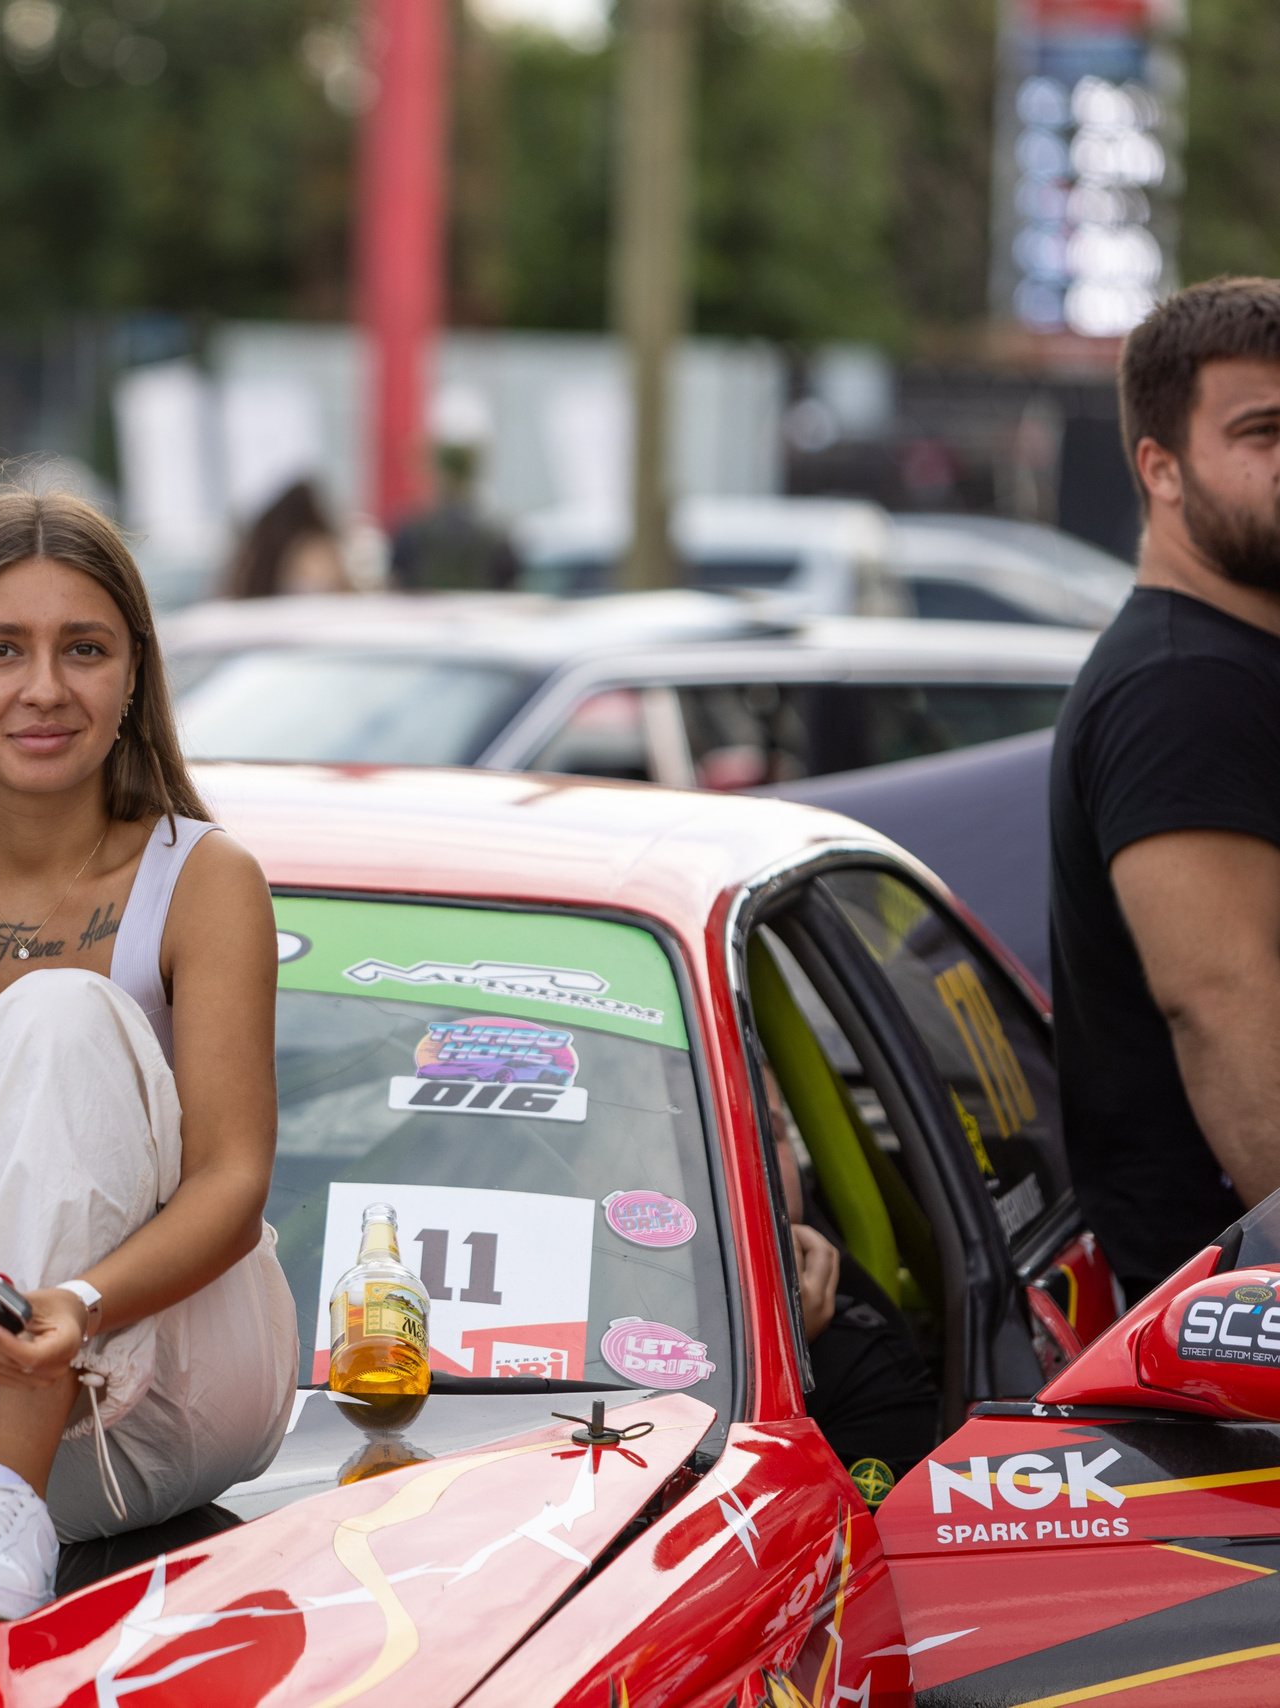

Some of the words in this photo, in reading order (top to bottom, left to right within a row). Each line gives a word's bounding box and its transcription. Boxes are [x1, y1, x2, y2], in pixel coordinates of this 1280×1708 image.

[426, 972, 663, 1018] AUTODROM
[429, 1022, 571, 1049] TURBO
[408, 1080, 566, 1114] 016
[613, 1202, 672, 1218] LET'S
[621, 1213, 682, 1231] DRIFT
[414, 1228, 502, 1305] 11
[626, 1335, 704, 1356] LET'S
[1182, 1347, 1212, 1357] STREET
[1215, 1349, 1251, 1360] CUSTOM
[496, 1356, 548, 1365] ENERGY
[623, 1354, 712, 1378] DRIFT
[928, 1447, 1126, 1514] NGK
[936, 1521, 1028, 1544] SPARK
[1036, 1517, 1130, 1539] PLUGS
